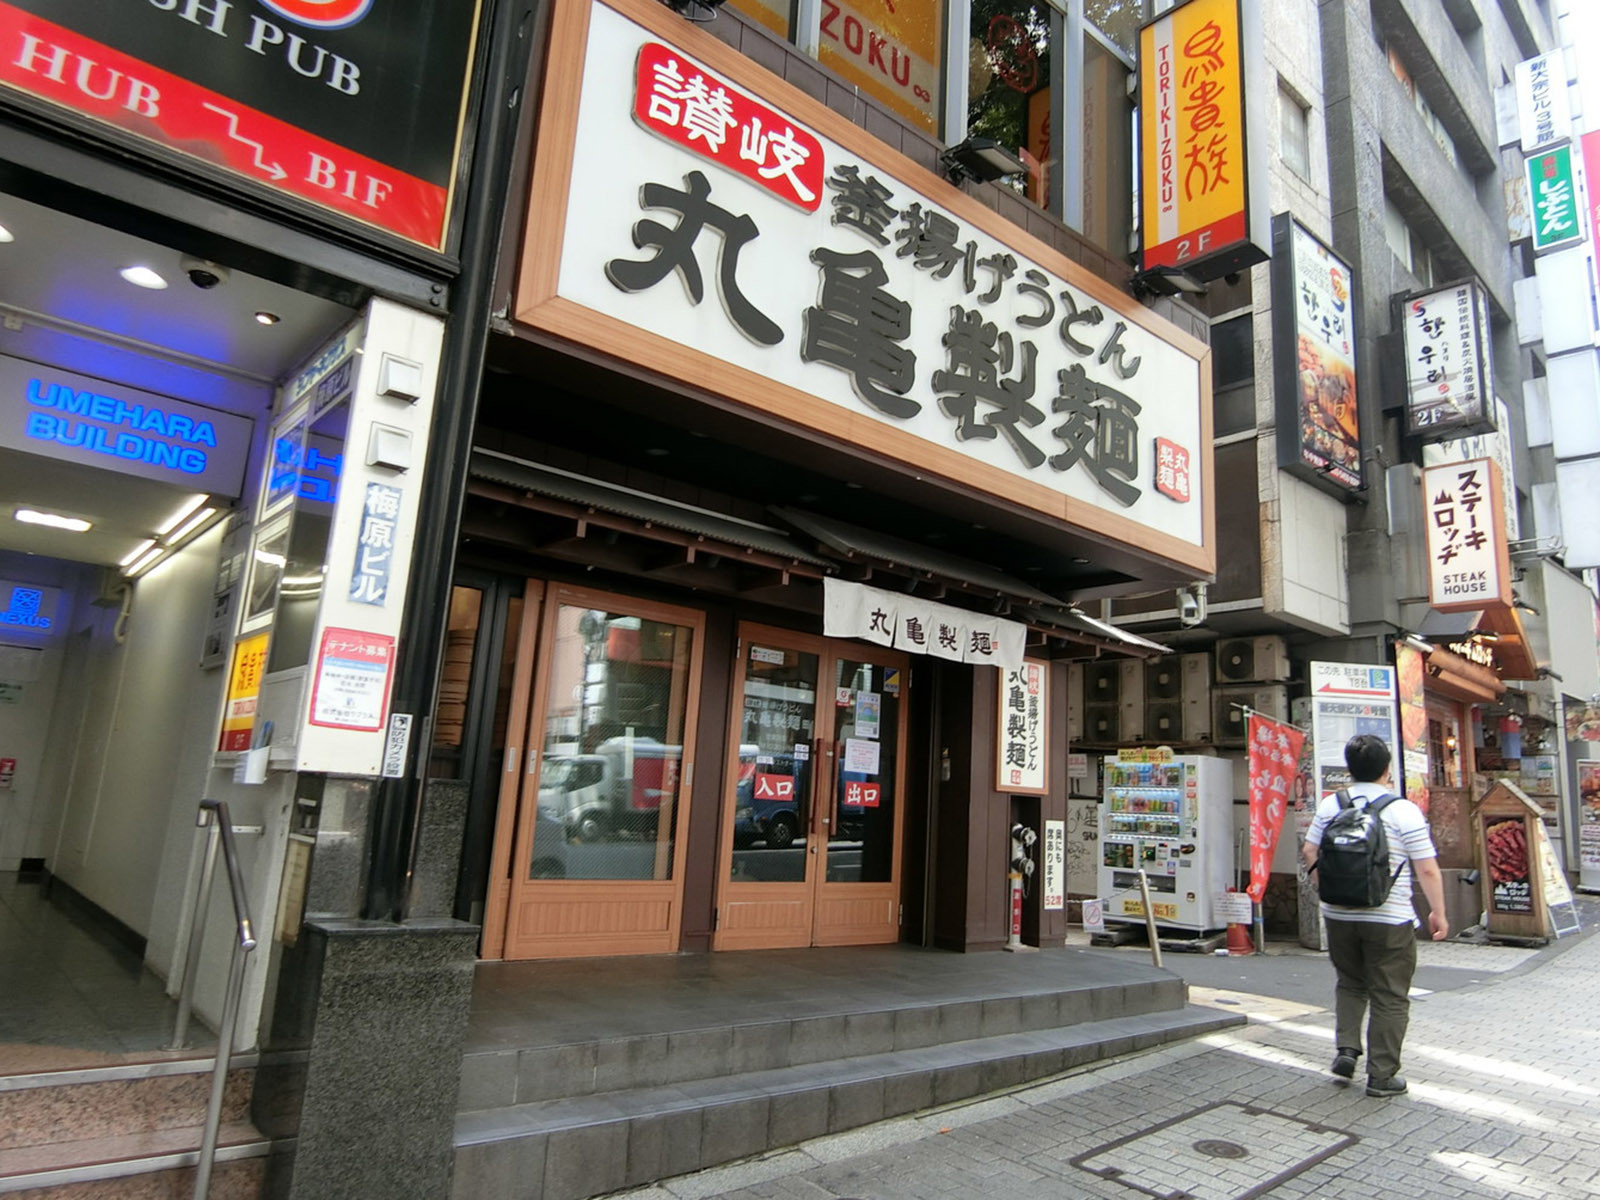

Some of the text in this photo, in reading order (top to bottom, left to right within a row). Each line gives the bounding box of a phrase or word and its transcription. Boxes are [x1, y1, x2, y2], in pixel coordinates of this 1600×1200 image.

[13, 32, 161, 118] HUB
[244, 14, 361, 96] PUB
[648, 59, 816, 202] 讃岐
[1158, 45, 1173, 203] TORIKIZOKU
[304, 151, 393, 209] B1F
[825, 164, 1142, 381] 釜揚げうどん
[1177, 230, 1212, 261] 2F
[604, 169, 1144, 508] 丸亀製麺
[26, 377, 217, 448] UMEHARA
[26, 411, 207, 474] BUILDING
[1416, 406, 1443, 427] 2F
[351, 483, 401, 604] 梅原ビル
[1457, 469, 1488, 550] ステーキ
[1443, 571, 1487, 585] STEAK
[1444, 581, 1487, 595] HOUSE
[868, 607, 994, 657] 丸亀製麺
[1005, 665, 1028, 769] 丸亀製麺
[756, 777, 793, 796] 入口
[847, 783, 878, 804] 出口
